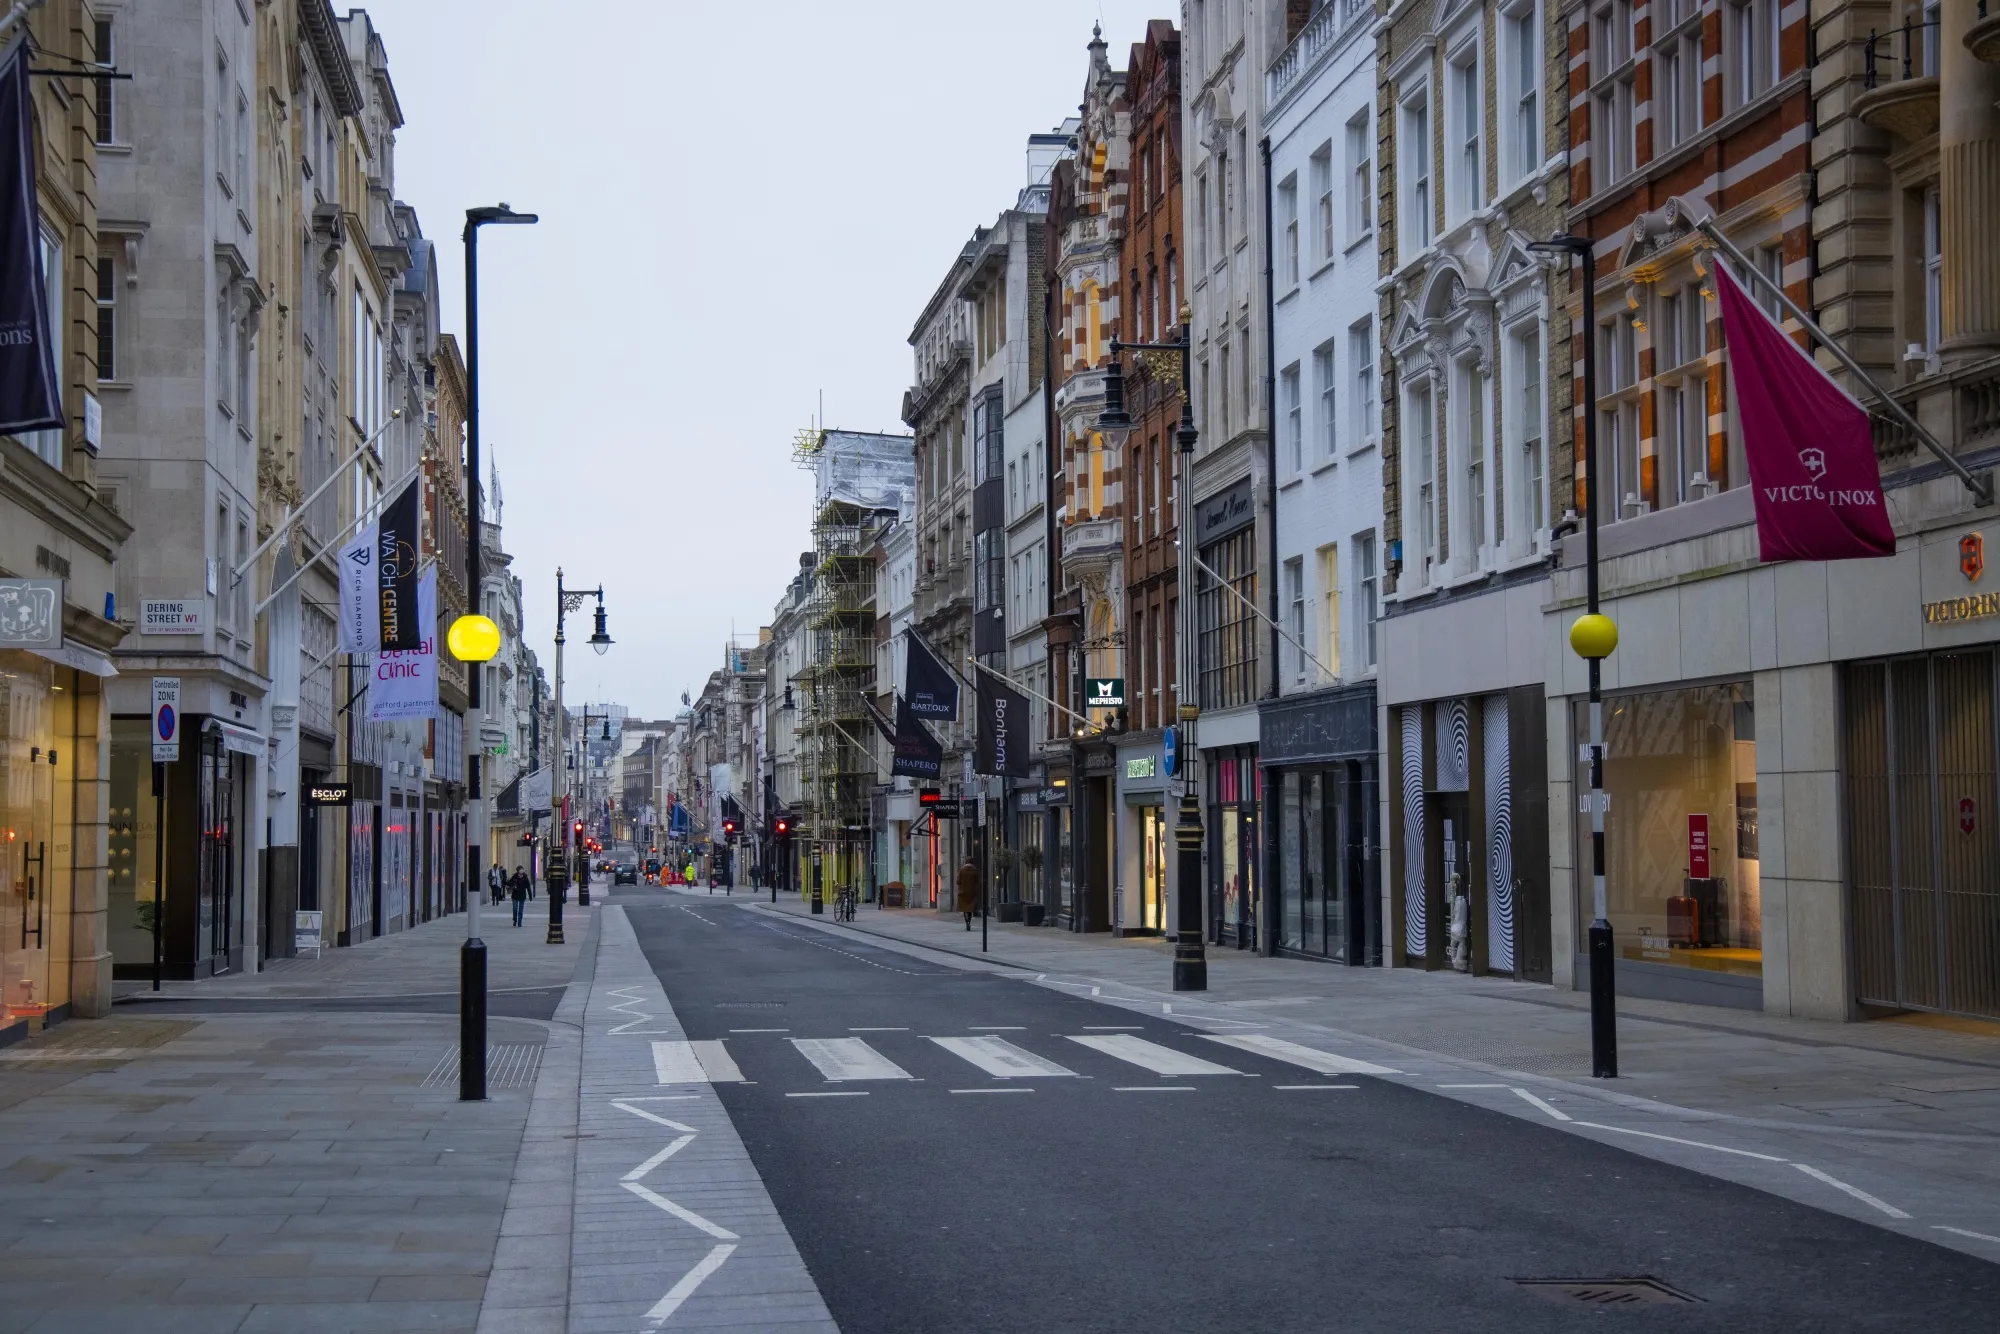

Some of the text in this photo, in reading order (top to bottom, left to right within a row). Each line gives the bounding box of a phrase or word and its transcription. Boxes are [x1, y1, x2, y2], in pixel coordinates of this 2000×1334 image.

[1764, 485, 1877, 506] VICTOINOX
[382, 530, 399, 643] WATCH CENTRE
[147, 603, 183, 613] DERING
[147, 614, 198, 623] STREET W1
[355, 595, 363, 647] DIAMONDS
[378, 659, 420, 680] Clinic
[154, 680, 179, 689] Controlled
[157, 691, 176, 701] ZONE
[1088, 697, 1123, 705] MEPHISTO
[403, 699, 435, 709] partners
[911, 702, 950, 712] BARTOUX
[995, 698, 1008, 771] Bonhams
[895, 757, 938, 770] SHAPERO
[312, 788, 347, 798] ÈSCLOT
